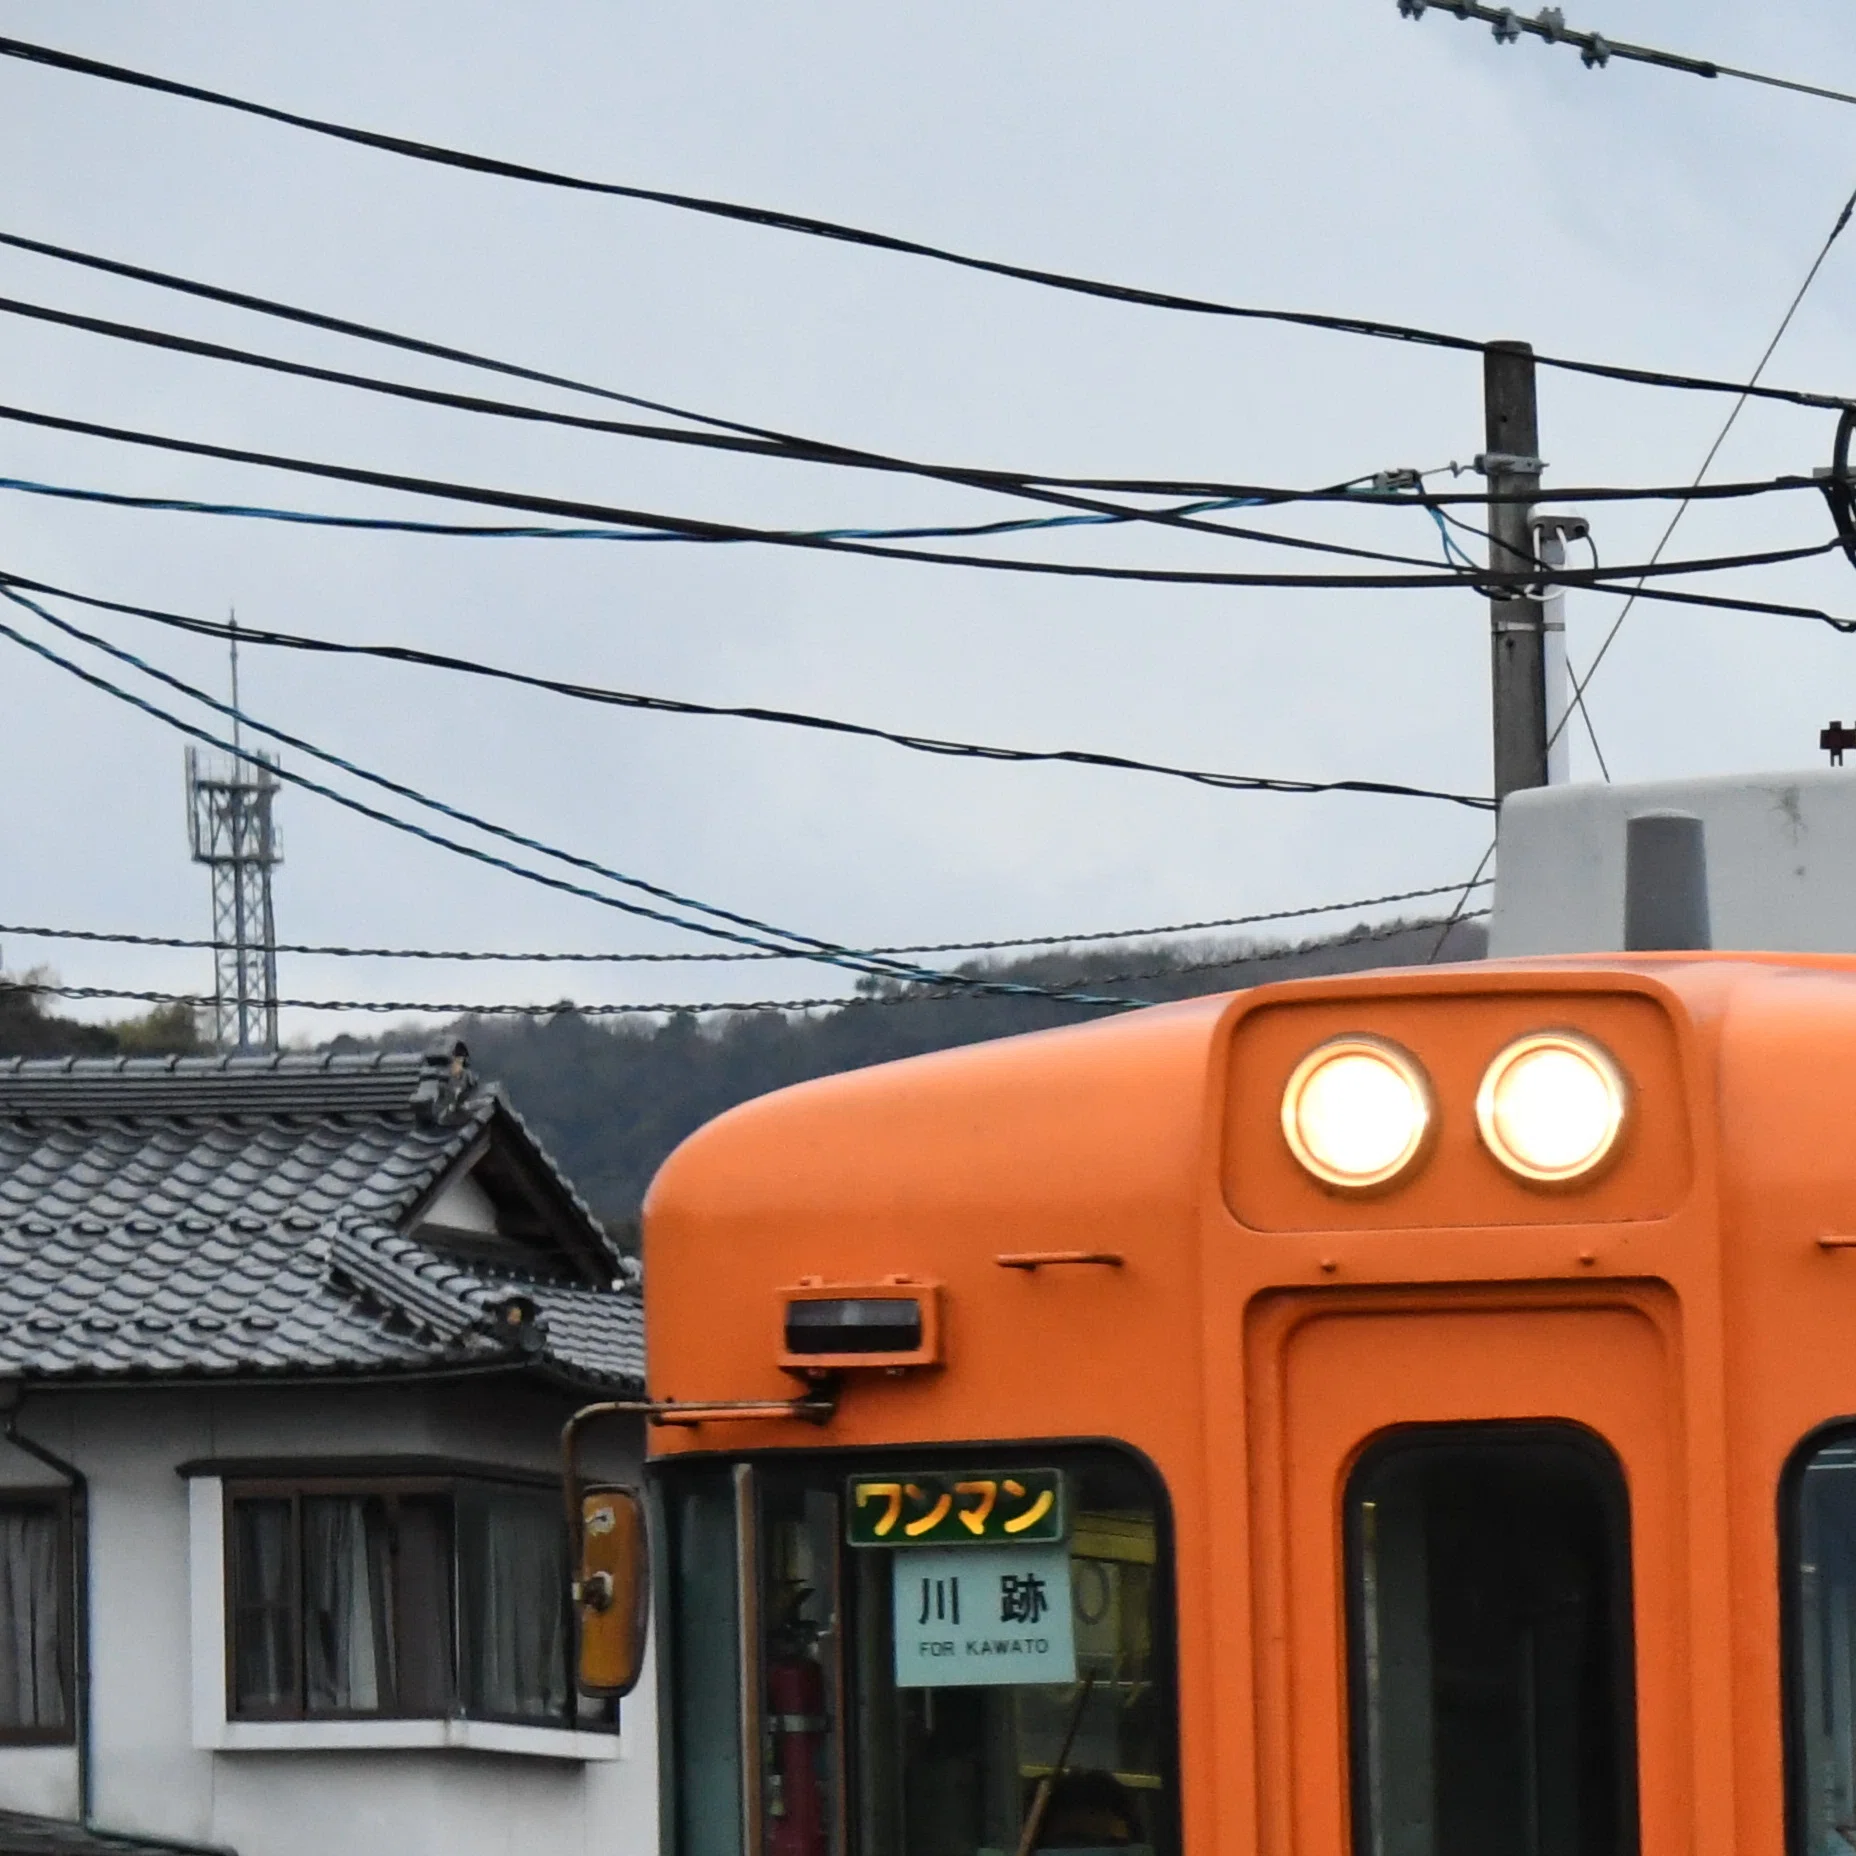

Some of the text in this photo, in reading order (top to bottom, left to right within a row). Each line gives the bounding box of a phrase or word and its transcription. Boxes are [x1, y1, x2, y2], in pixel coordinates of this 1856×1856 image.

[856, 1479, 1054, 1537] ワンマン
[918, 1571, 1049, 1626] 川跡
[919, 1638, 1050, 1657] FOR KAWATO
